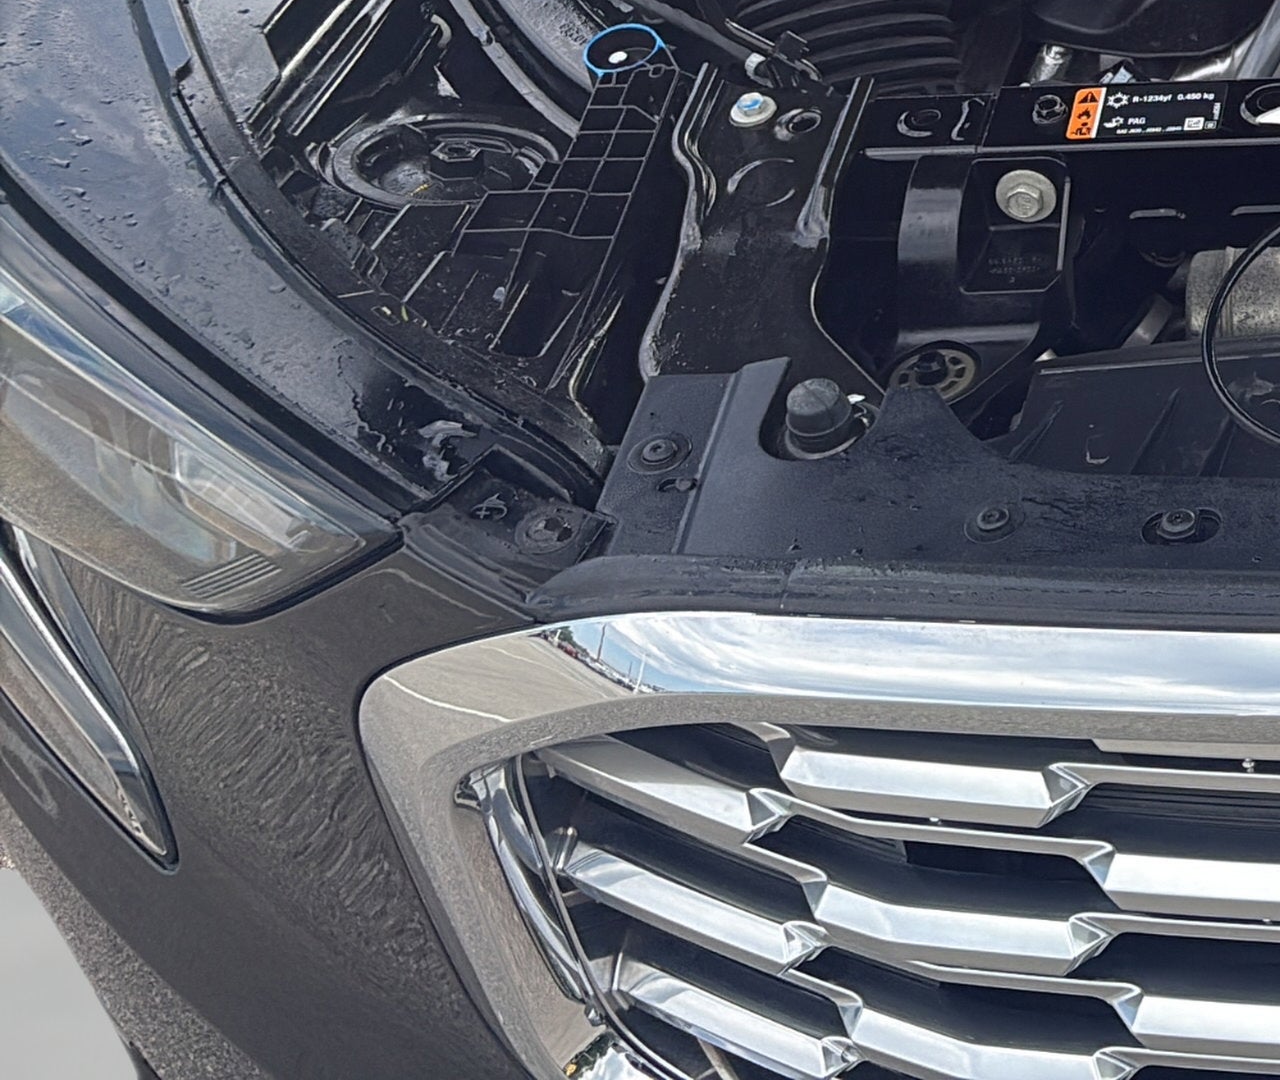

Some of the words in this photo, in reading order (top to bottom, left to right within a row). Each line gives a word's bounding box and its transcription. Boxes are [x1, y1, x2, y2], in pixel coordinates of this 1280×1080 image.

[1132, 94, 1173, 104] R-1234yf
[1177, 93, 1202, 101] 0.450
[1202, 92, 1216, 101] kg
[1127, 117, 1146, 125] PAG
